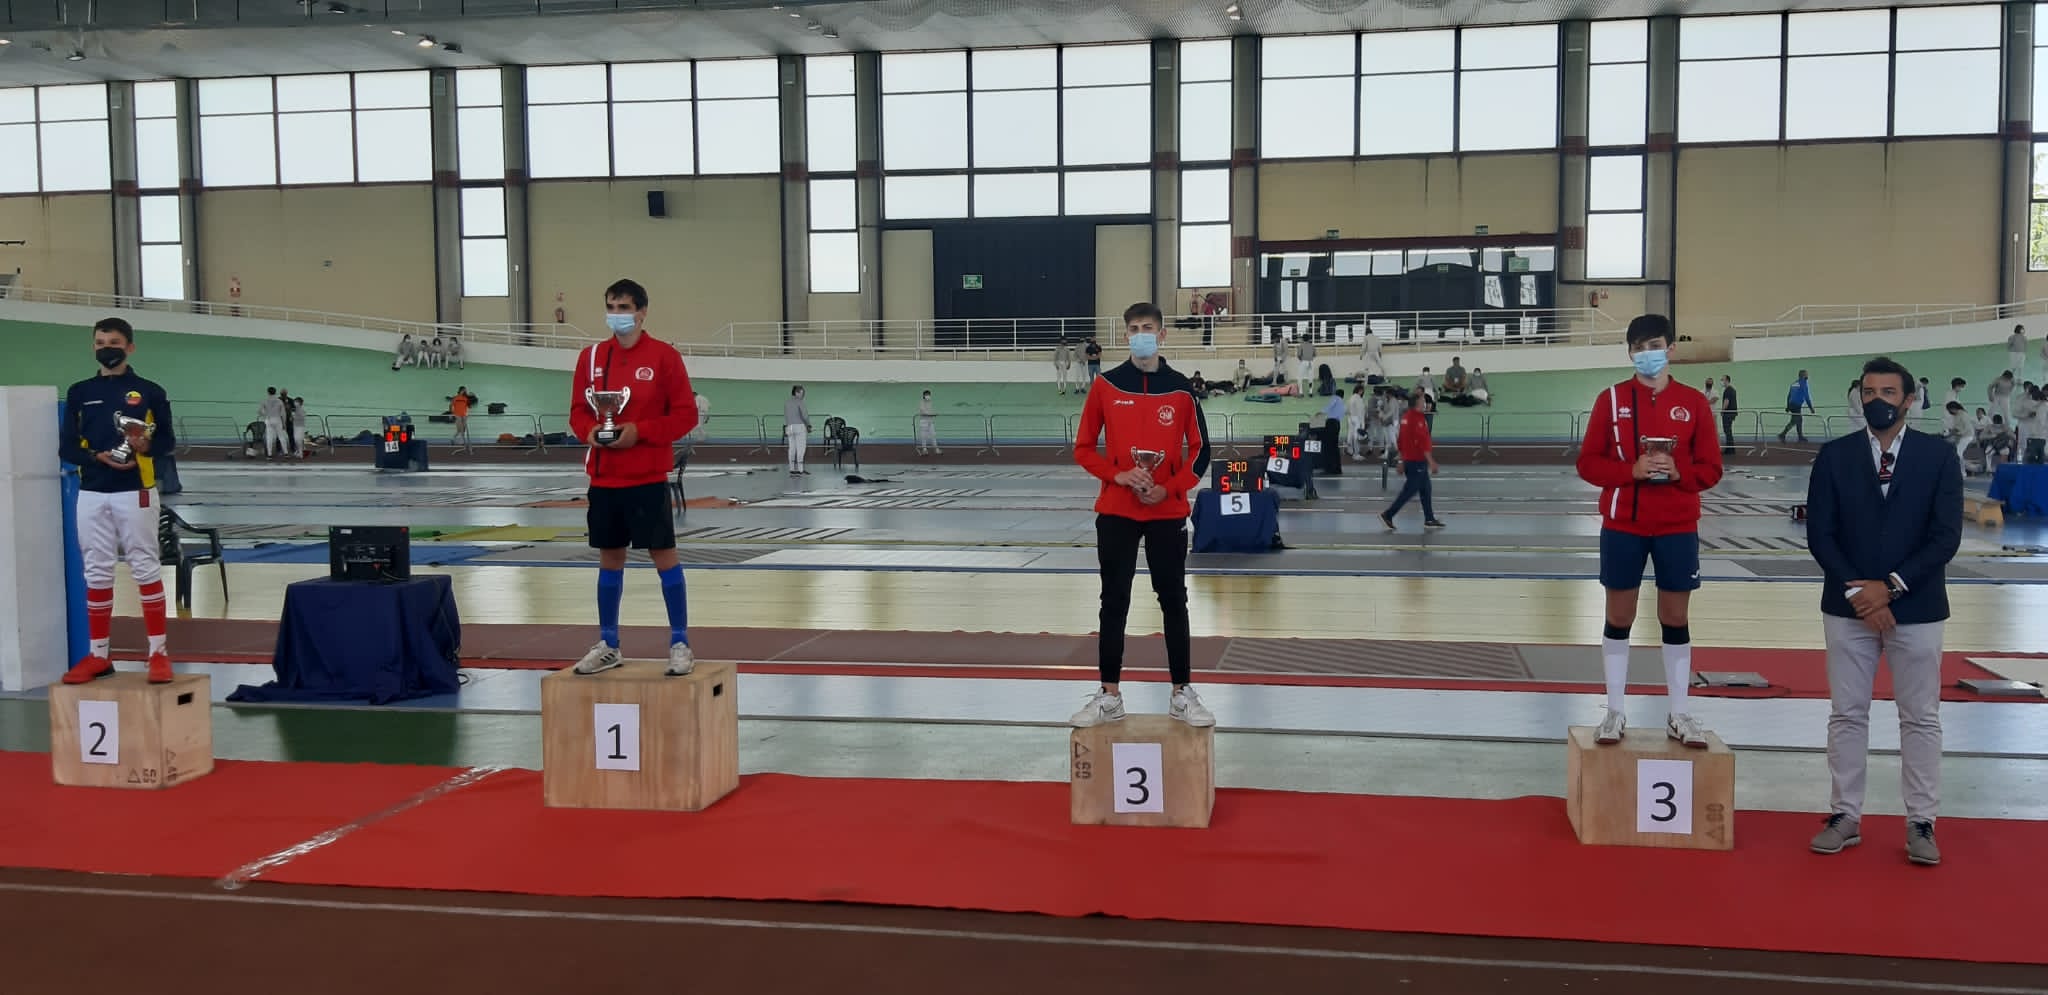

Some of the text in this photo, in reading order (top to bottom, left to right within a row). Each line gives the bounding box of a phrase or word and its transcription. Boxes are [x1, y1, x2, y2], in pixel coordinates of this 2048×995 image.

[1273, 436, 1289, 445] 3:00
[1307, 442, 1320, 451] 13
[1292, 447, 1301, 460] 0
[1227, 461, 1248, 472] 3:00
[1274, 459, 1283, 471] 9
[1220, 475, 1262, 492] 5 1
[1231, 496, 1243, 512] 5
[89, 722, 107, 756] 2
[607, 723, 627, 759] 1
[1126, 767, 1149, 805] 3
[1651, 782, 1677, 822] 3
